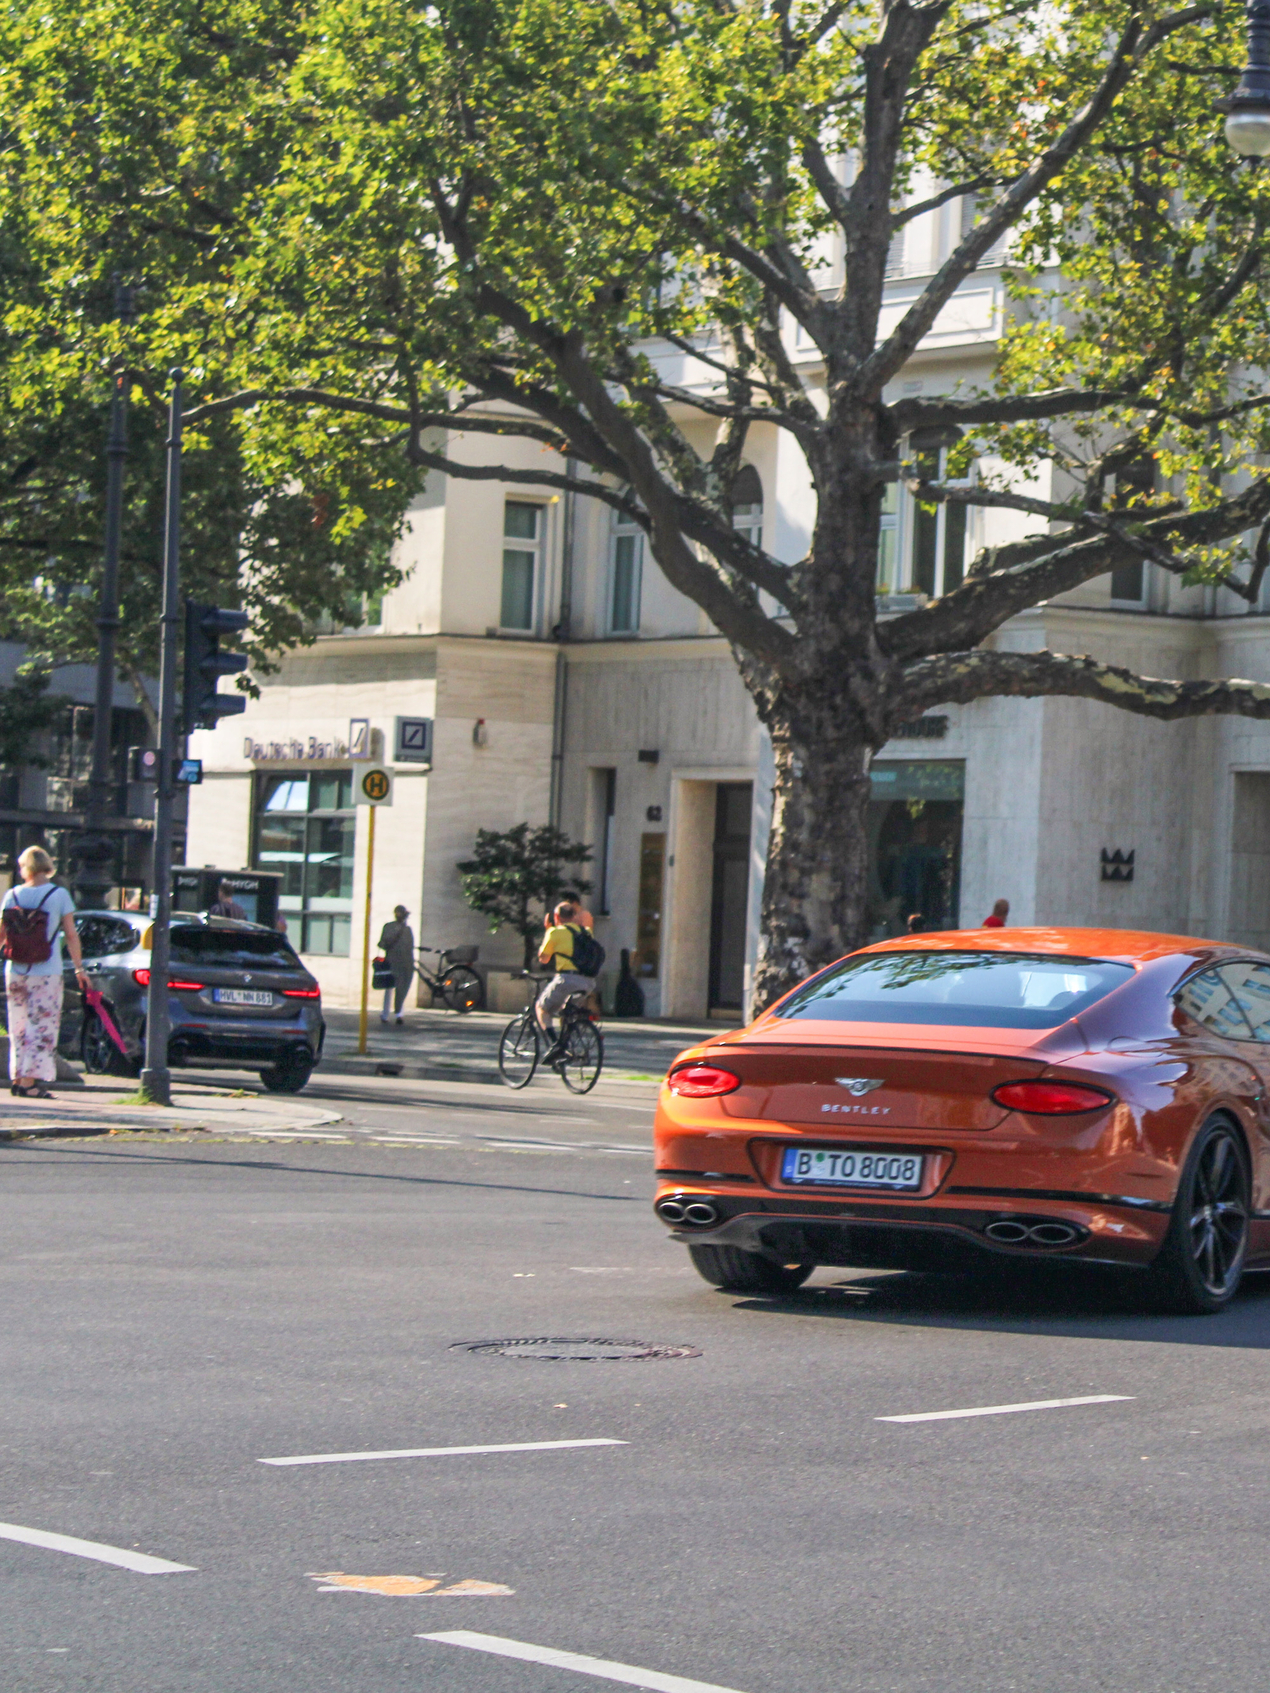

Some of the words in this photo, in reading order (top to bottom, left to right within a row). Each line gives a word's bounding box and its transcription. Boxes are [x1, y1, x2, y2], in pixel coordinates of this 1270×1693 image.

[244, 737, 304, 760] Deutsche
[308, 736, 347, 760] Bank
[370, 777, 383, 794] H
[821, 1103, 891, 1115] BENTLEY
[797, 1152, 812, 1175] B
[828, 1154, 856, 1178] TO
[860, 1156, 916, 1181] 8008
